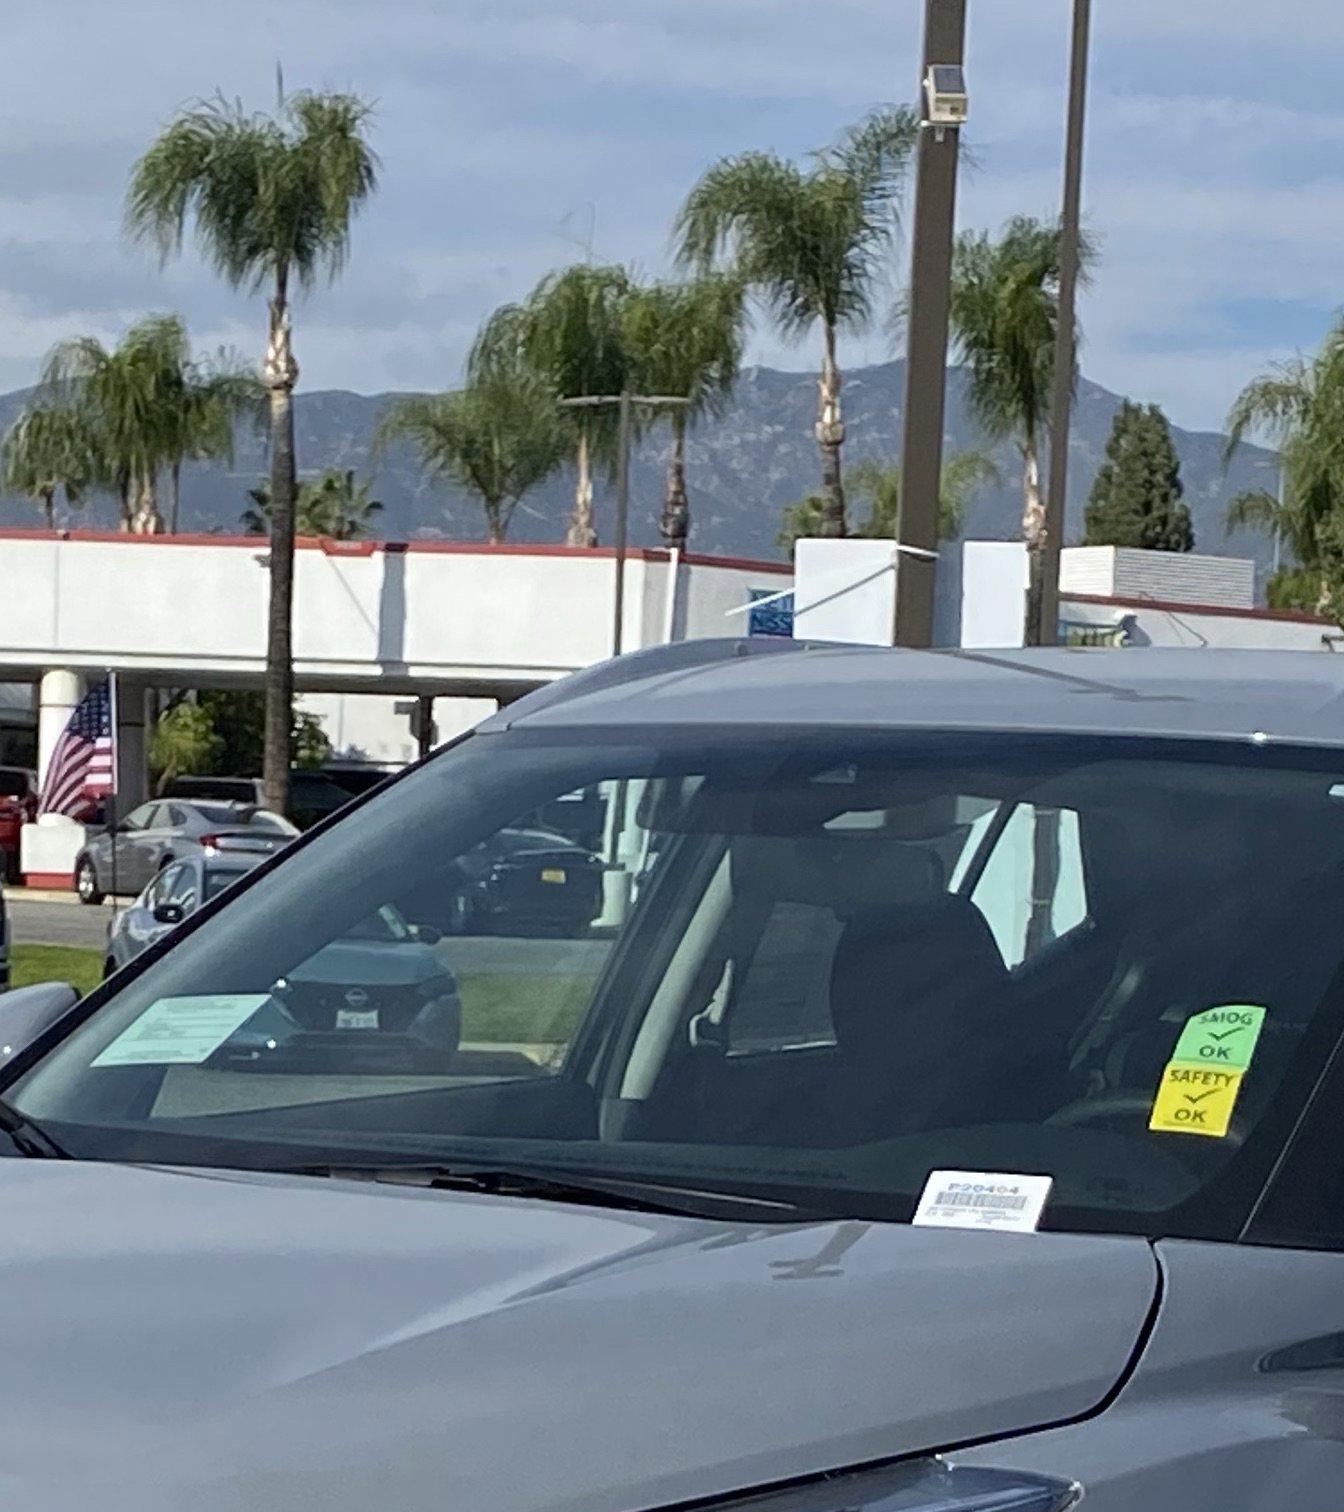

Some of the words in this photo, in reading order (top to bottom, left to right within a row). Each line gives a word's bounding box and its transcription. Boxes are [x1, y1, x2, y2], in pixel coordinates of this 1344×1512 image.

[1198, 1012, 1254, 1026] SMOG
[1199, 1045, 1232, 1059] OK
[1169, 1070, 1236, 1087] SAFETY
[1174, 1109, 1207, 1122] OK
